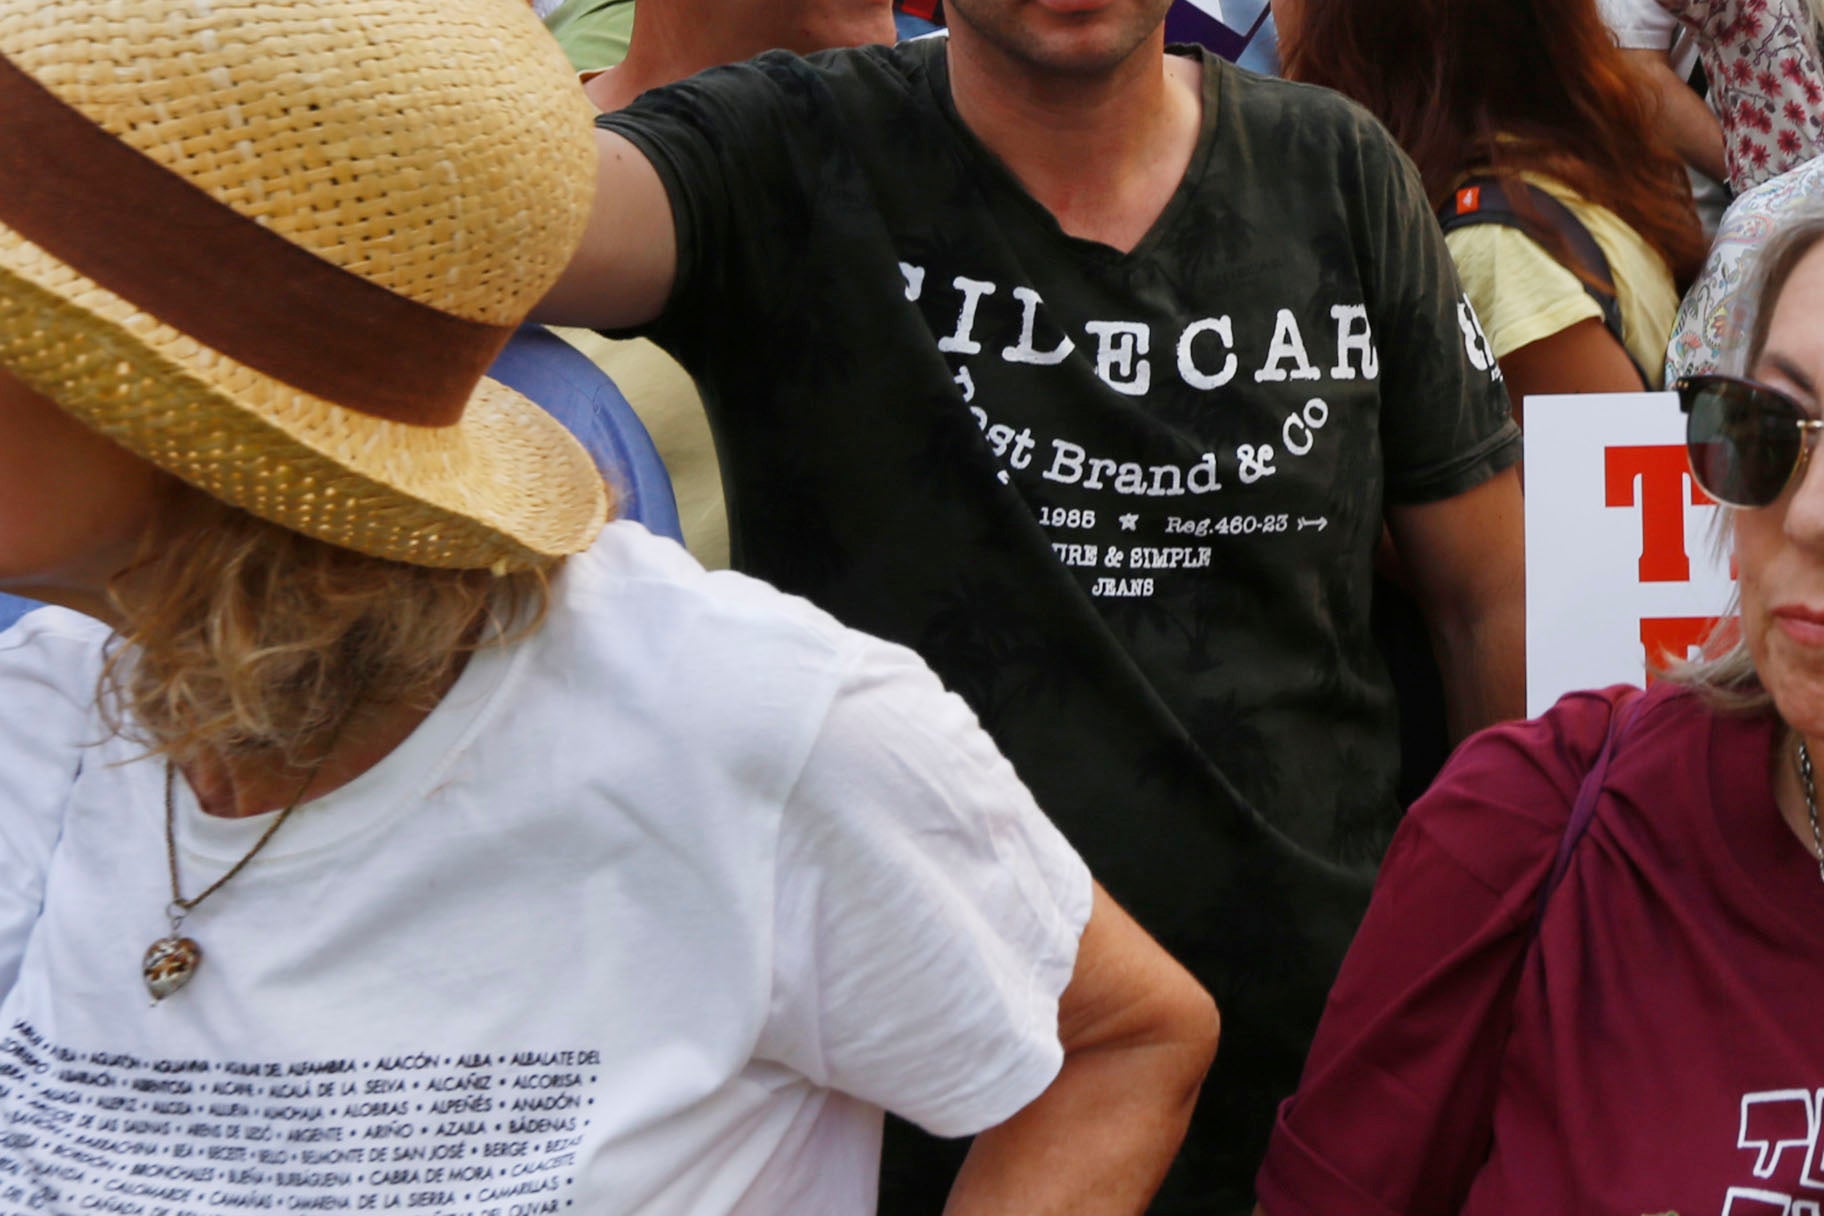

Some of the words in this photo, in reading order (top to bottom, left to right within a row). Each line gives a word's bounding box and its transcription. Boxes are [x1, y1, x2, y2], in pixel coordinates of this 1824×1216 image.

[1043, 439, 1222, 497] Brand
[1237, 443, 1276, 484] &
[1283, 397, 1328, 456] Co
[1104, 545, 1124, 568] &
[1130, 547, 1212, 568] SIMPLE
[1092, 578, 1154, 597] JEANS
[455, 1053, 492, 1068] ALBA
